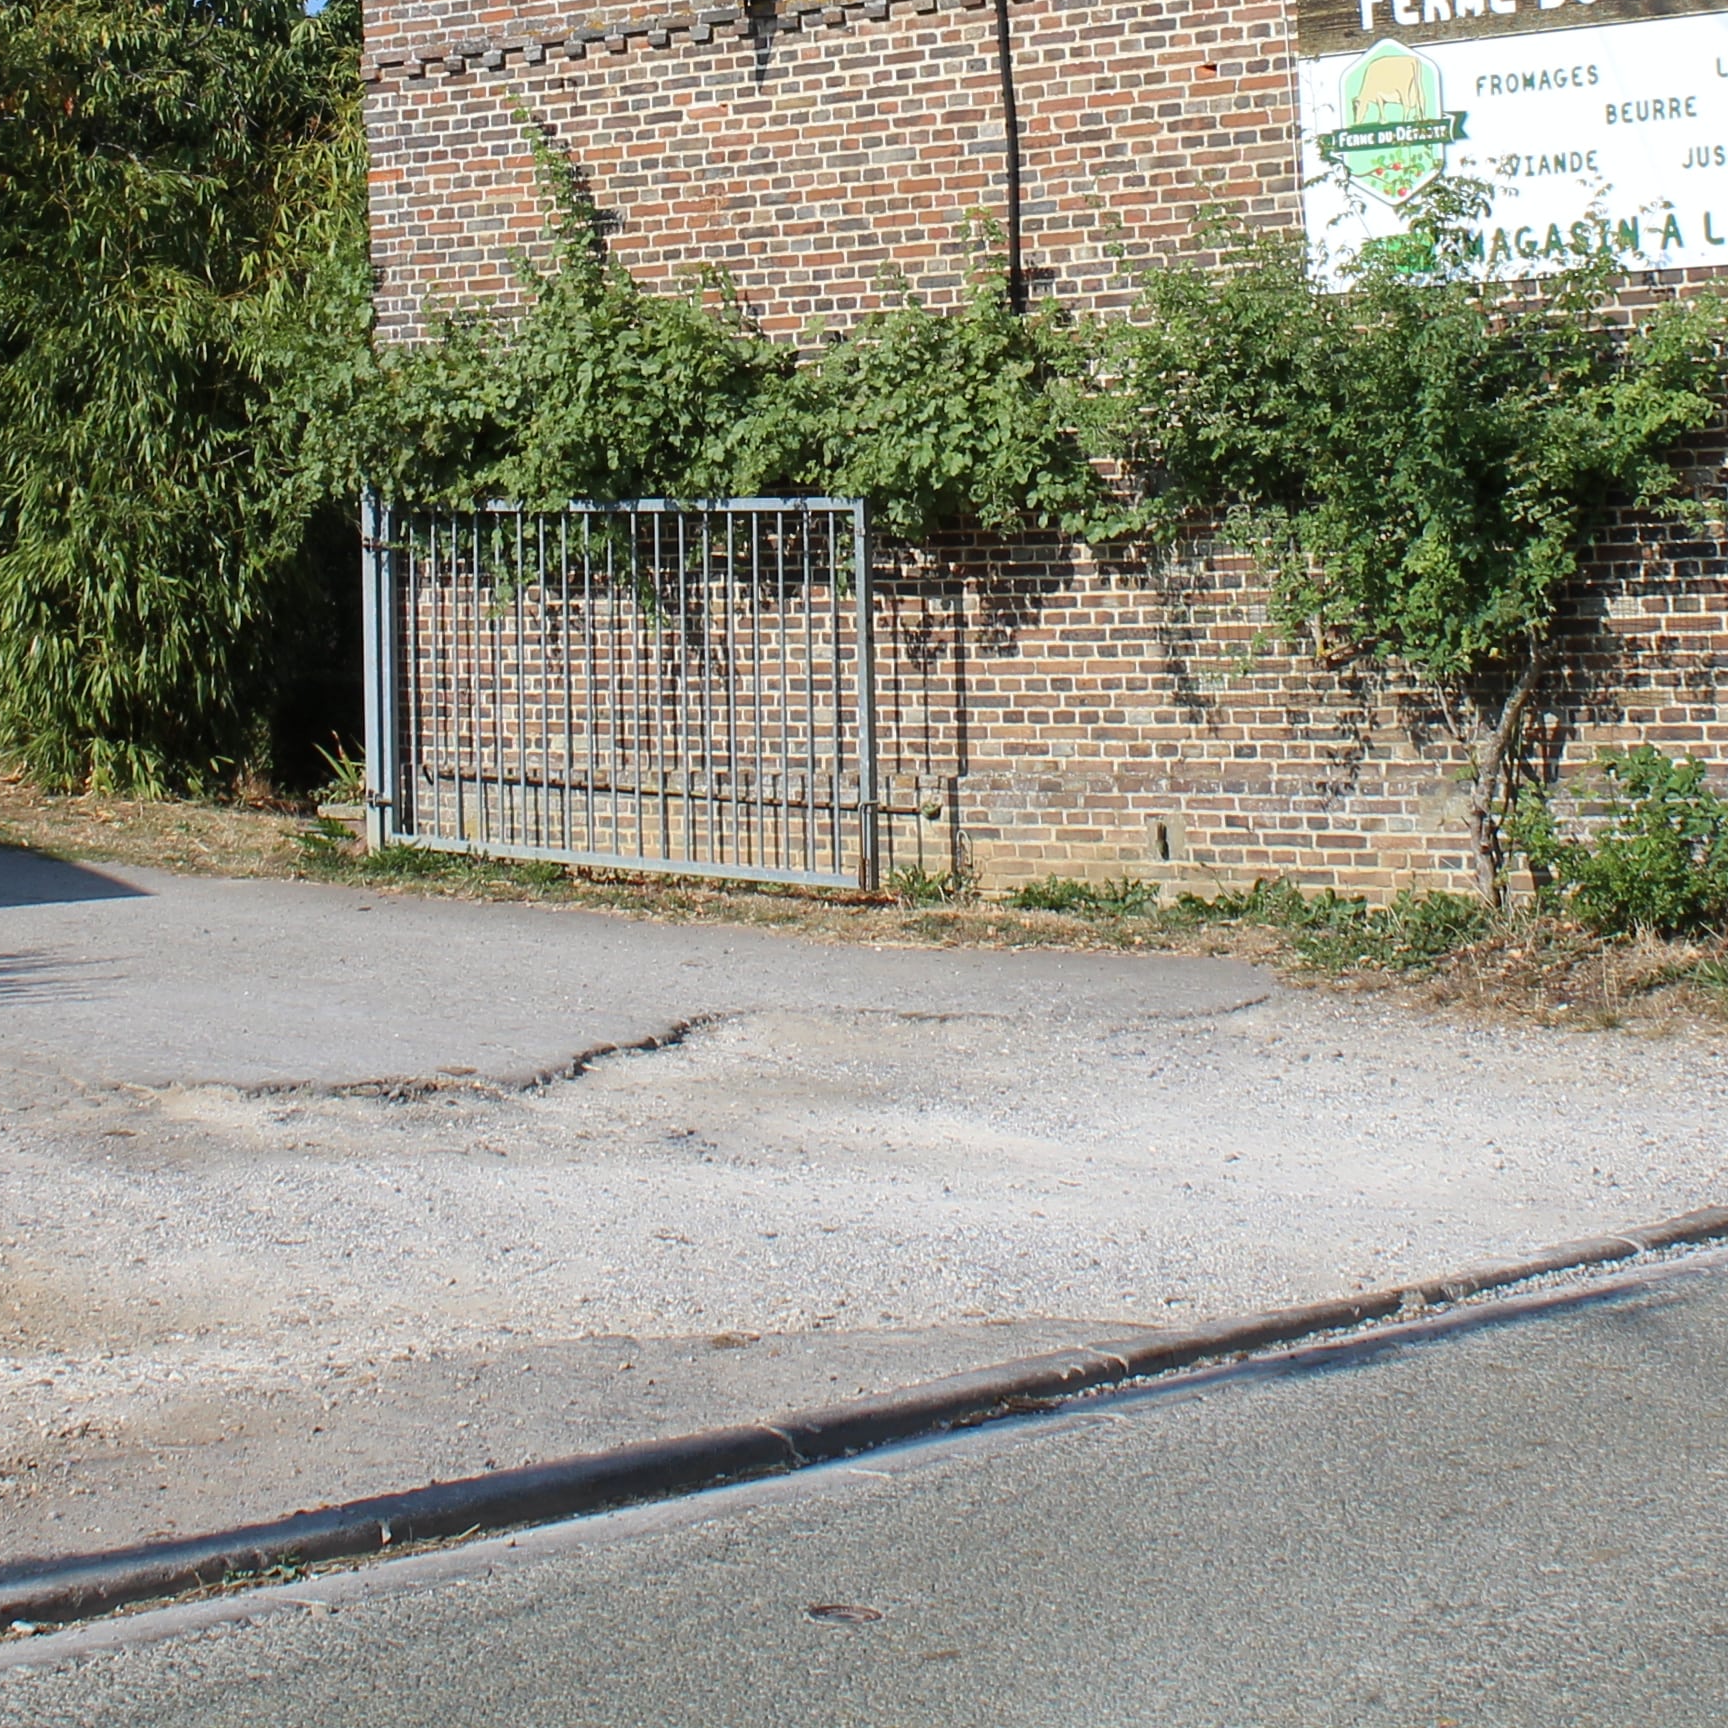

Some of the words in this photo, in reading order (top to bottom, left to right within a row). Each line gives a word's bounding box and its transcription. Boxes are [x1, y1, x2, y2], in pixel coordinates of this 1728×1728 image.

[1475, 64, 1599, 97] FROMAGES
[1605, 96, 1698, 125] BEURRE
[1338, 131, 1376, 148] FERME
[1377, 131, 1394, 145] DU
[1506, 149, 1598, 177] VIANDE
[1682, 145, 1726, 169] JUS
[1460, 215, 1640, 262] MAGASIN
